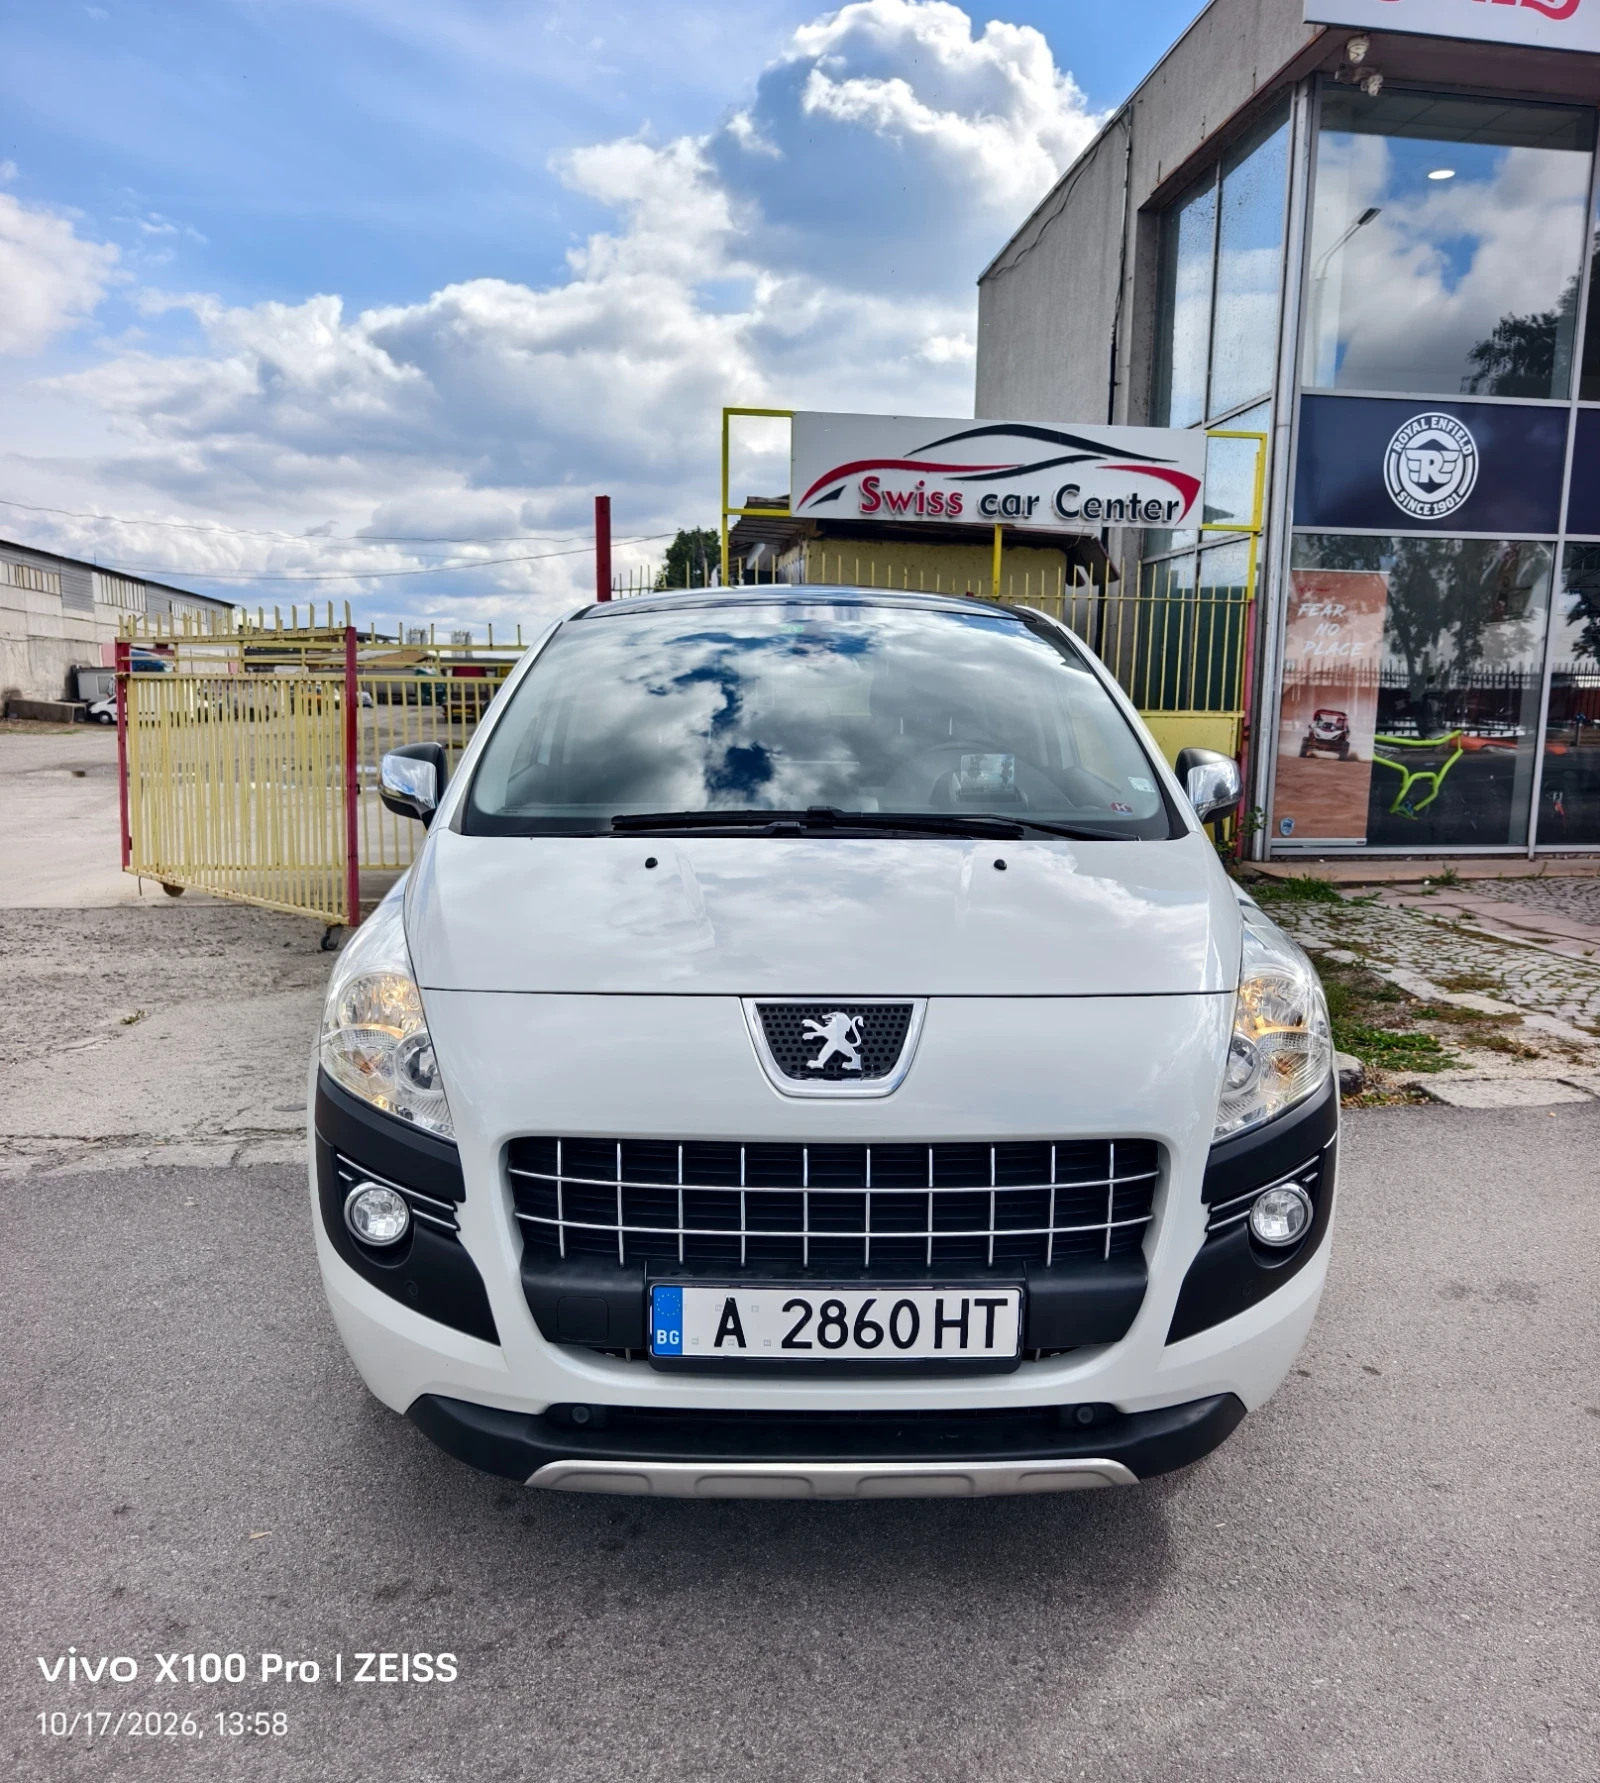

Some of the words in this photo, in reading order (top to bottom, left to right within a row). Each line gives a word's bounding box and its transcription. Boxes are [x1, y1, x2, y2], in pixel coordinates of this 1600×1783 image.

[1392, 418, 1429, 453] ROYAL
[1431, 416, 1473, 455] ENFIELD
[858, 475, 964, 516] Swiss
[977, 493, 1040, 518] car
[1055, 482, 1180, 522] Center
[1396, 490, 1431, 515] SINCE
[1433, 492, 1461, 515] 1901
[1297, 602, 1346, 618] FEAR
[1314, 622, 1340, 637] NO
[1302, 640, 1366, 657] PLACE
[713, 1296, 747, 1348] A
[656, 1329, 680, 1345] BG
